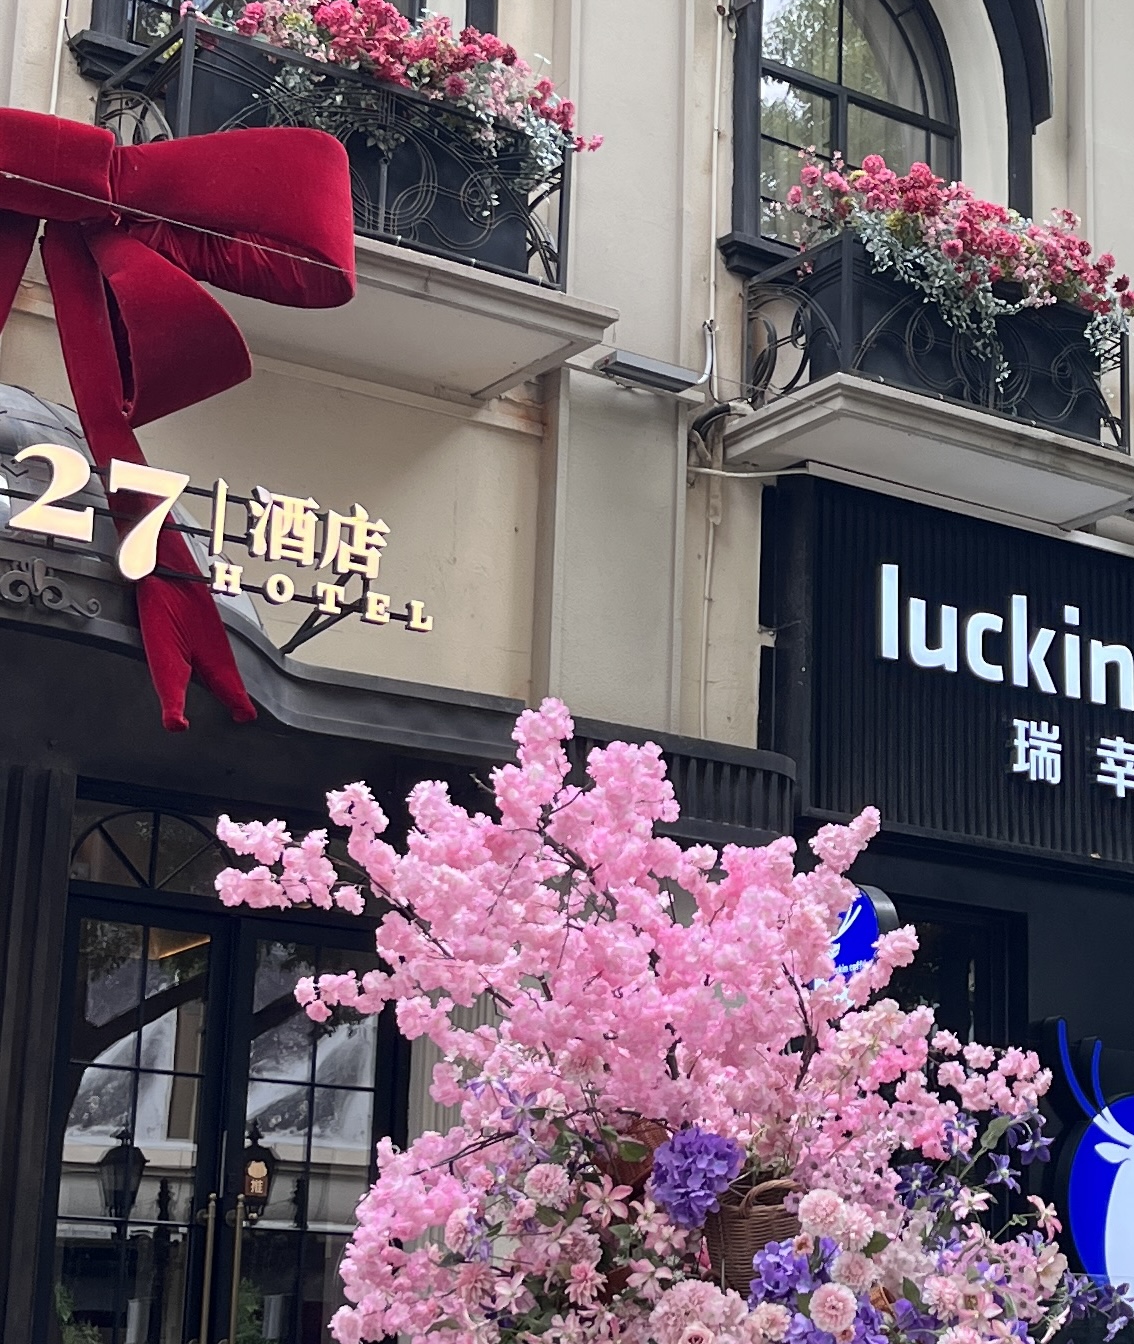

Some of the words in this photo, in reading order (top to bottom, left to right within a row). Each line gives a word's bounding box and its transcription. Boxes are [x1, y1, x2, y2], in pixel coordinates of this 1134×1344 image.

[248, 484, 391, 580] 酒店
[210, 561, 434, 632] HOTEL
[880, 563, 1134, 712] luckin
